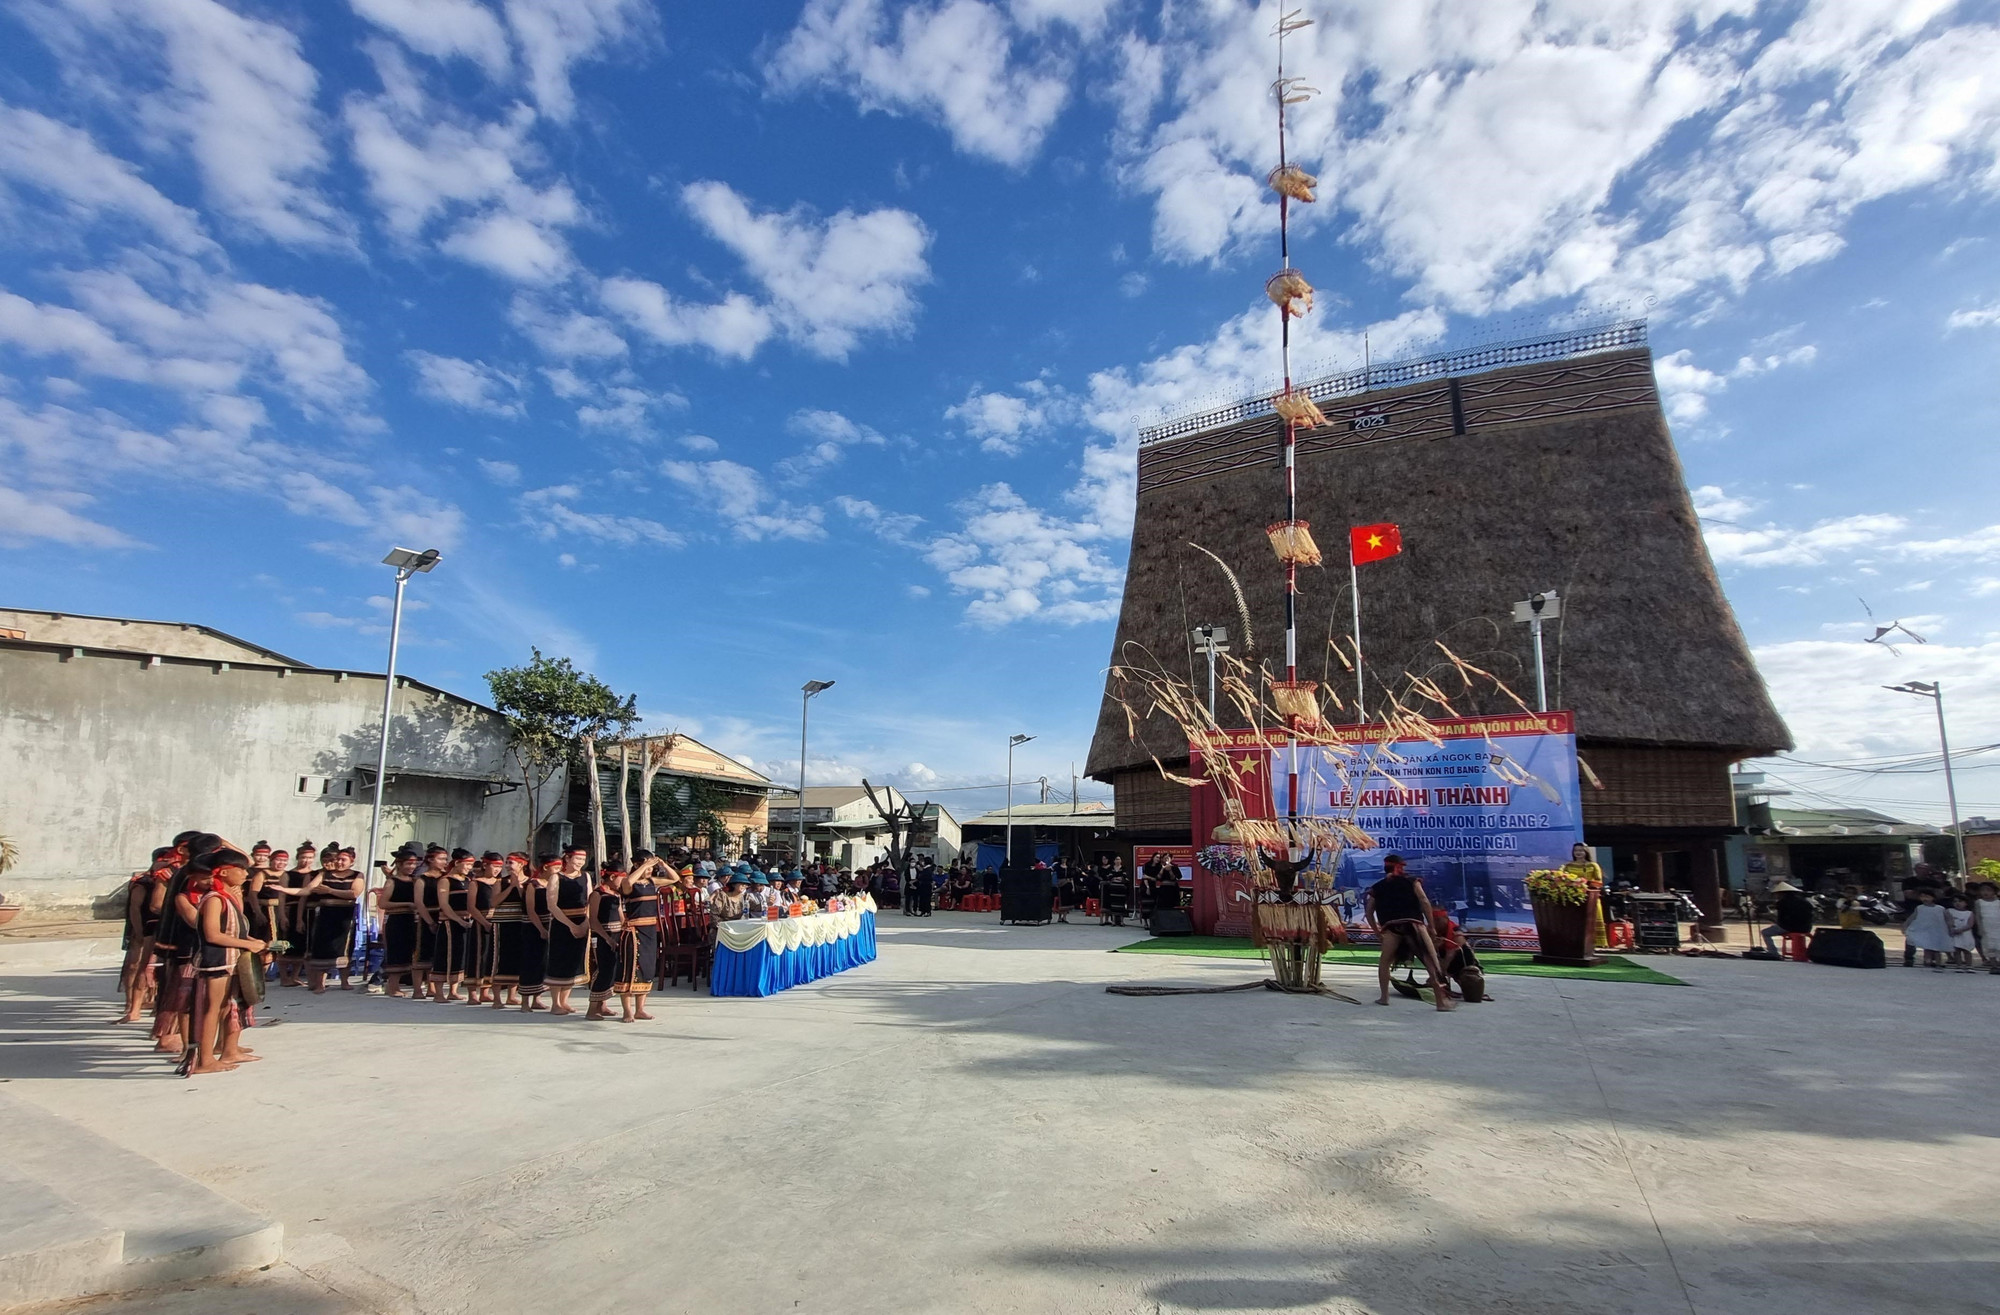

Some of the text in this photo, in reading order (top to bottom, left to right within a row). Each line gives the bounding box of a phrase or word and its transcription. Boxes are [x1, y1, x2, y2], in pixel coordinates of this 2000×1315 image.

[1354, 415, 1385, 430] 2025
[1236, 733, 1267, 746] CỘNG
[1339, 728, 1362, 741] CHỦ
[1470, 720, 1511, 733] MUÔN
[1514, 718, 1547, 732] NĂM
[1350, 758, 1370, 766] BAN
[1457, 765, 1480, 774] BANG
[1481, 765, 1487, 774] 2
[1358, 785, 1430, 807] KHÁNH
[1434, 783, 1510, 806] THÀNH
[1357, 814, 1382, 829] VĂN
[1385, 814, 1410, 829] HÓA
[1412, 813, 1445, 829] THÔN
[1500, 814, 1536, 828] BANG
[1540, 814, 1549, 828] 2
[1405, 832, 1434, 849] TỈNH
[1437, 832, 1481, 851] QUẢNG
[1484, 833, 1517, 849] NGÃI
